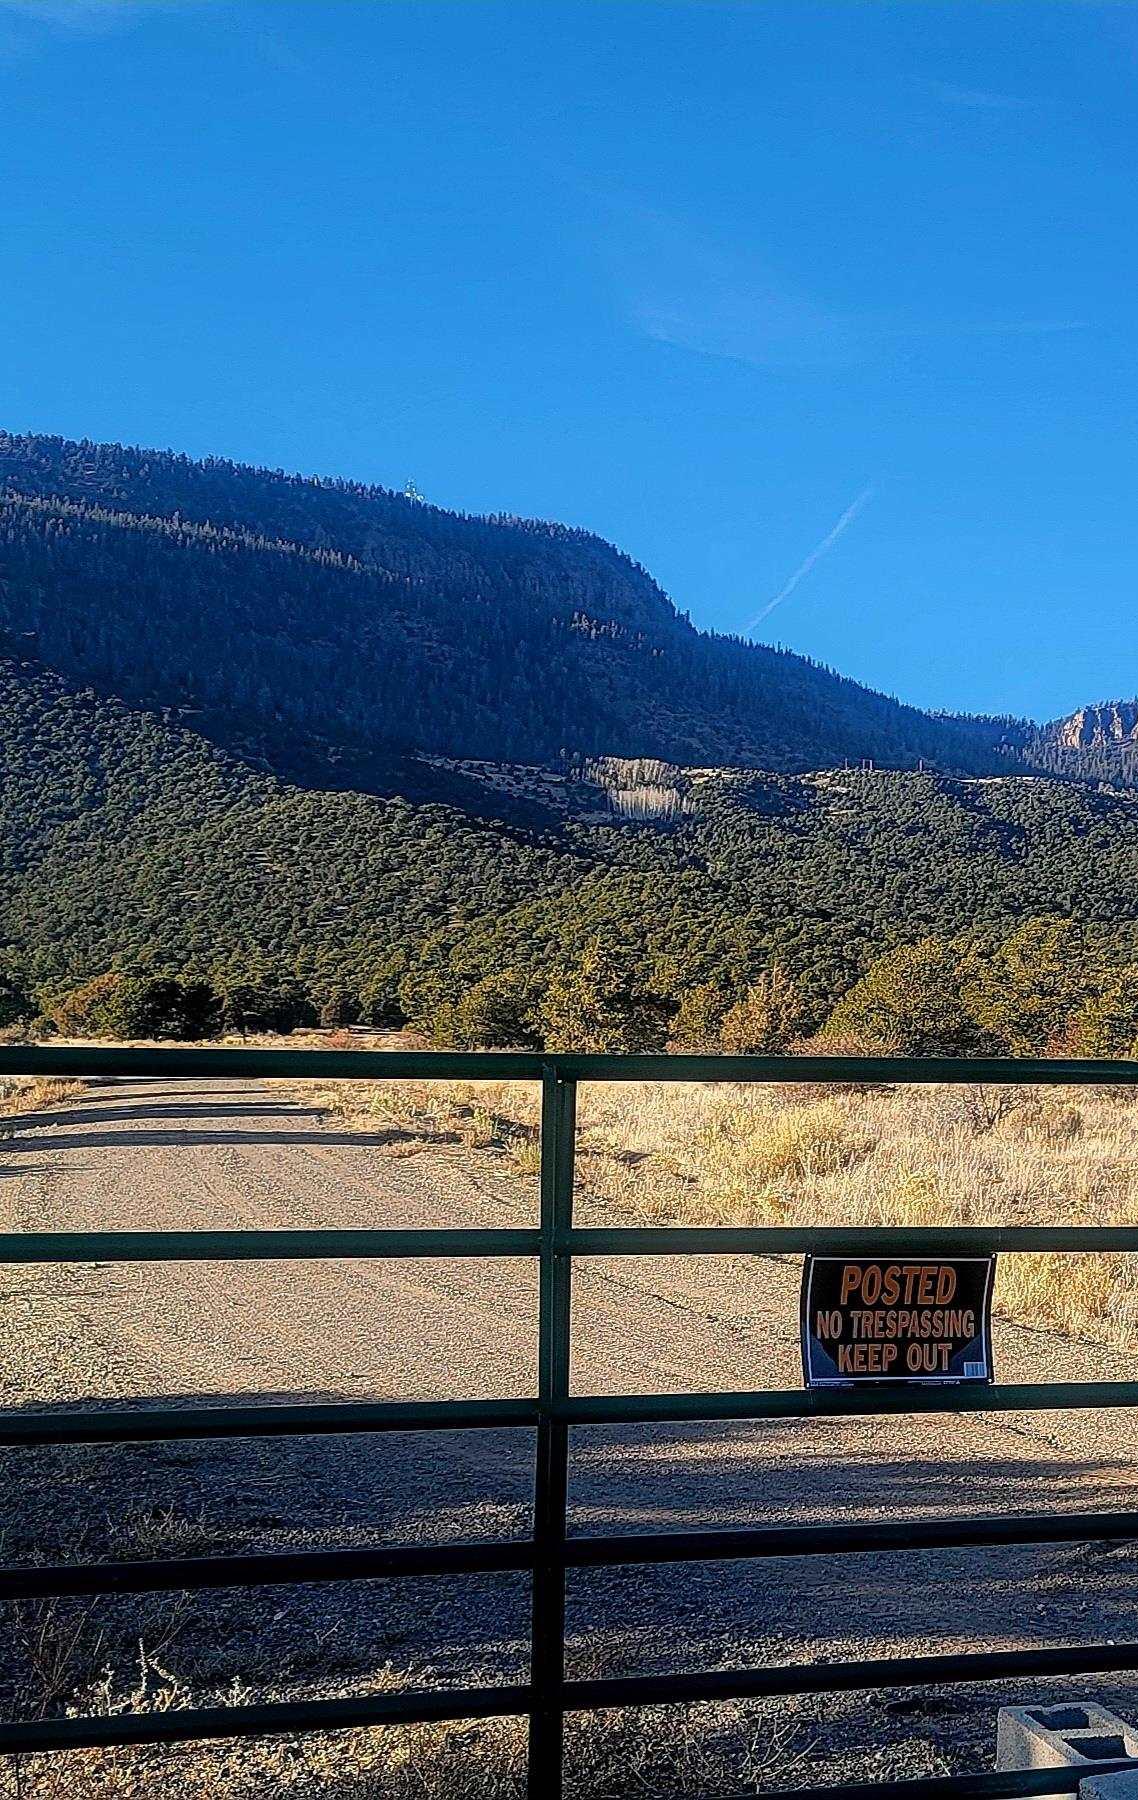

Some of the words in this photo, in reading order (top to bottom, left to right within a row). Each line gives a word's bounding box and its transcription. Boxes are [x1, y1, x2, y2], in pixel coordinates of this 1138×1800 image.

[840, 1264, 957, 1305] POSTED
[816, 1310, 843, 1339] NO
[850, 1309, 975, 1339] TRESPASSING
[838, 1343, 898, 1373] KEEP
[906, 1342, 952, 1372] OUT
